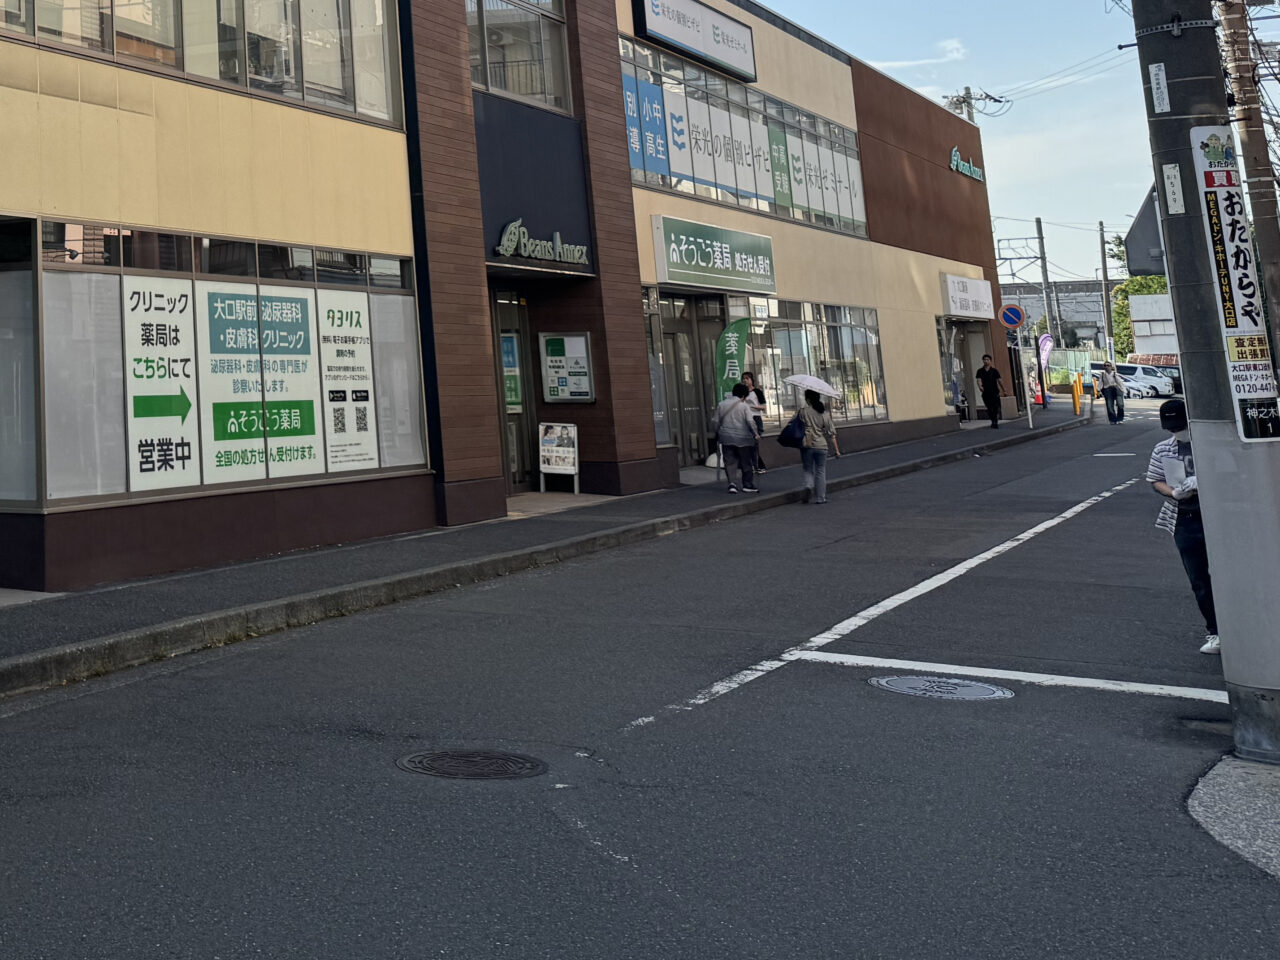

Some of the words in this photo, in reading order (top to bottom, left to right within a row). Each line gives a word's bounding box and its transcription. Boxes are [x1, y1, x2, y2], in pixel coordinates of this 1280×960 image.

[520, 226, 554, 262] Beans
[553, 231, 589, 265] Annex
[679, 235, 732, 270] そうごう薬局
[734, 251, 771, 276] 処方せん受付
[1222, 190, 1261, 327] おたからや
[129, 291, 189, 315] クリニック
[327, 309, 362, 328] タヨリス
[140, 323, 181, 348] 薬局は
[1234, 337, 1268, 349] 査定無
[723, 332, 741, 381] 薬局
[1237, 348, 1270, 360] 出張買
[132, 357, 192, 380] こちらにて
[238, 410, 301, 432] そうごう薬局
[1246, 407, 1279, 419] 神之木
[1267, 422, 1273, 433] 1
[137, 436, 192, 473] 営業中
[215, 446, 317, 468] 全国の処方せん受付けます。
